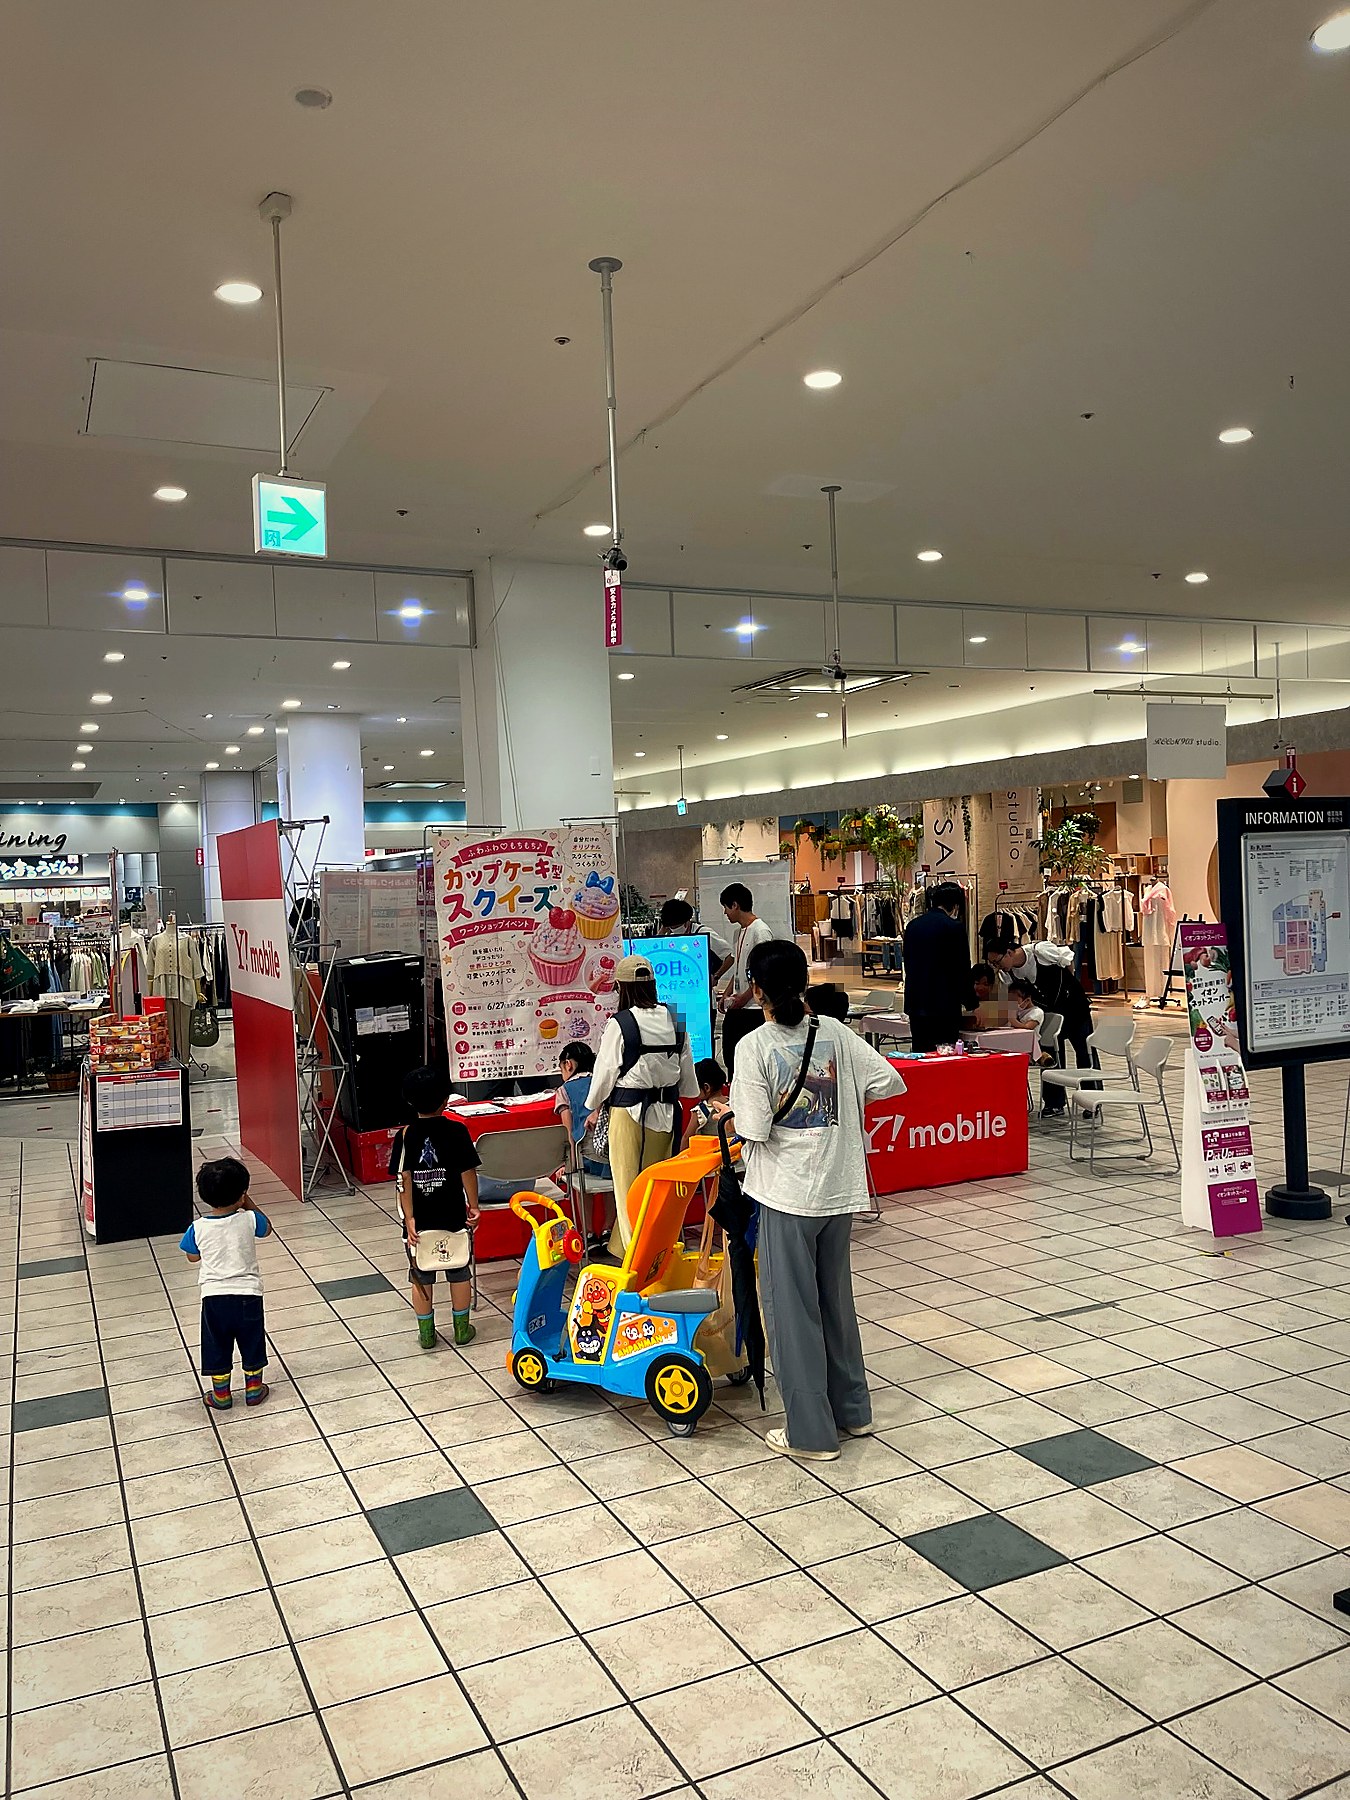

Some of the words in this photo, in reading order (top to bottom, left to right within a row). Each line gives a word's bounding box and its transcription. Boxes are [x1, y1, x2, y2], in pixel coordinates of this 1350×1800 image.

[1196, 738, 1222, 746] studio.
[1245, 810, 1324, 825] INFORMATION
[443, 858, 563, 890] カップケーキ型
[442, 884, 558, 923] スクイーズ
[459, 920, 530, 936] ワークショップイベント
[1184, 934, 1224, 942] イオンネットスーパー
[230, 923, 249, 972] Y!
[250, 940, 281, 979] mobile
[469, 960, 512, 970] 世界にひとつの
[466, 968, 517, 980] 可愛いスクイーズを
[658, 979, 700, 991] へ行こう!
[1201, 988, 1219, 997] イオン
[1191, 993, 1231, 1007] ネットスーパー
[471, 1018, 514, 1031] 完全予約制
[494, 1038, 516, 1051] 無料
[467, 1060, 501, 1068] 会場はこちら
[481, 1065, 525, 1073] 格安スマホの窓口
[909, 1110, 1007, 1149] mobile
[617, 1335, 663, 1358] ANPANMAN
